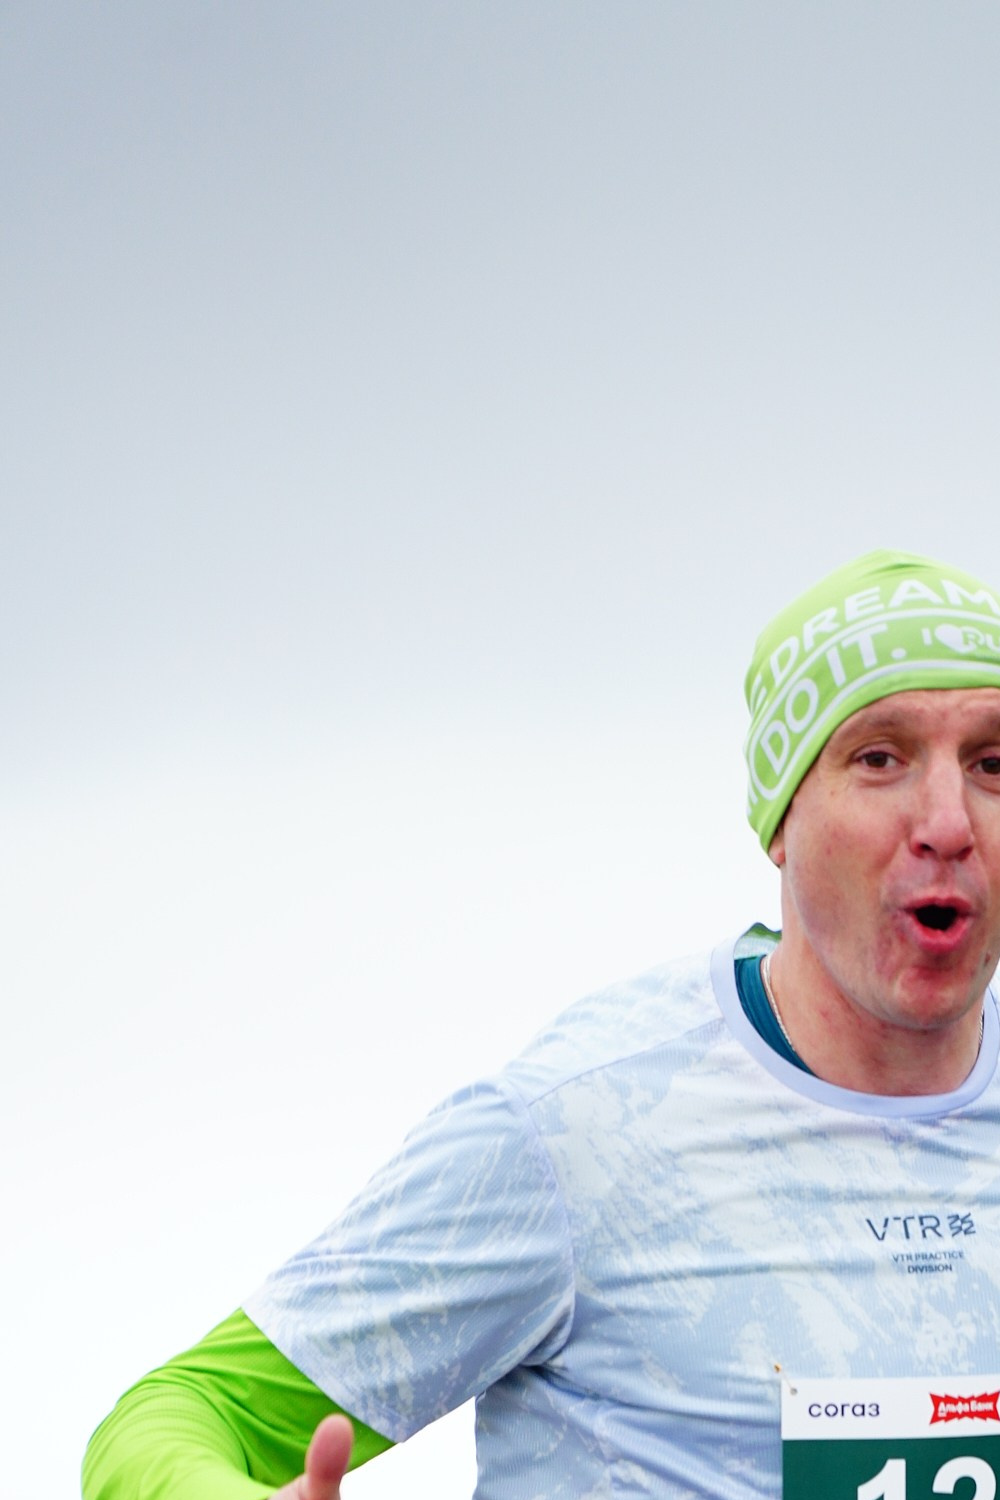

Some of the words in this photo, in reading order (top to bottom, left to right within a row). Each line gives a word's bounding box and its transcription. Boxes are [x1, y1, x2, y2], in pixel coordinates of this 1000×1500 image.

[759, 678, 819, 777] DO
[826, 623, 907, 687] IT.
[914, 1250, 965, 1261] PRACTICE
[907, 1264, 953, 1274] DIVISION
